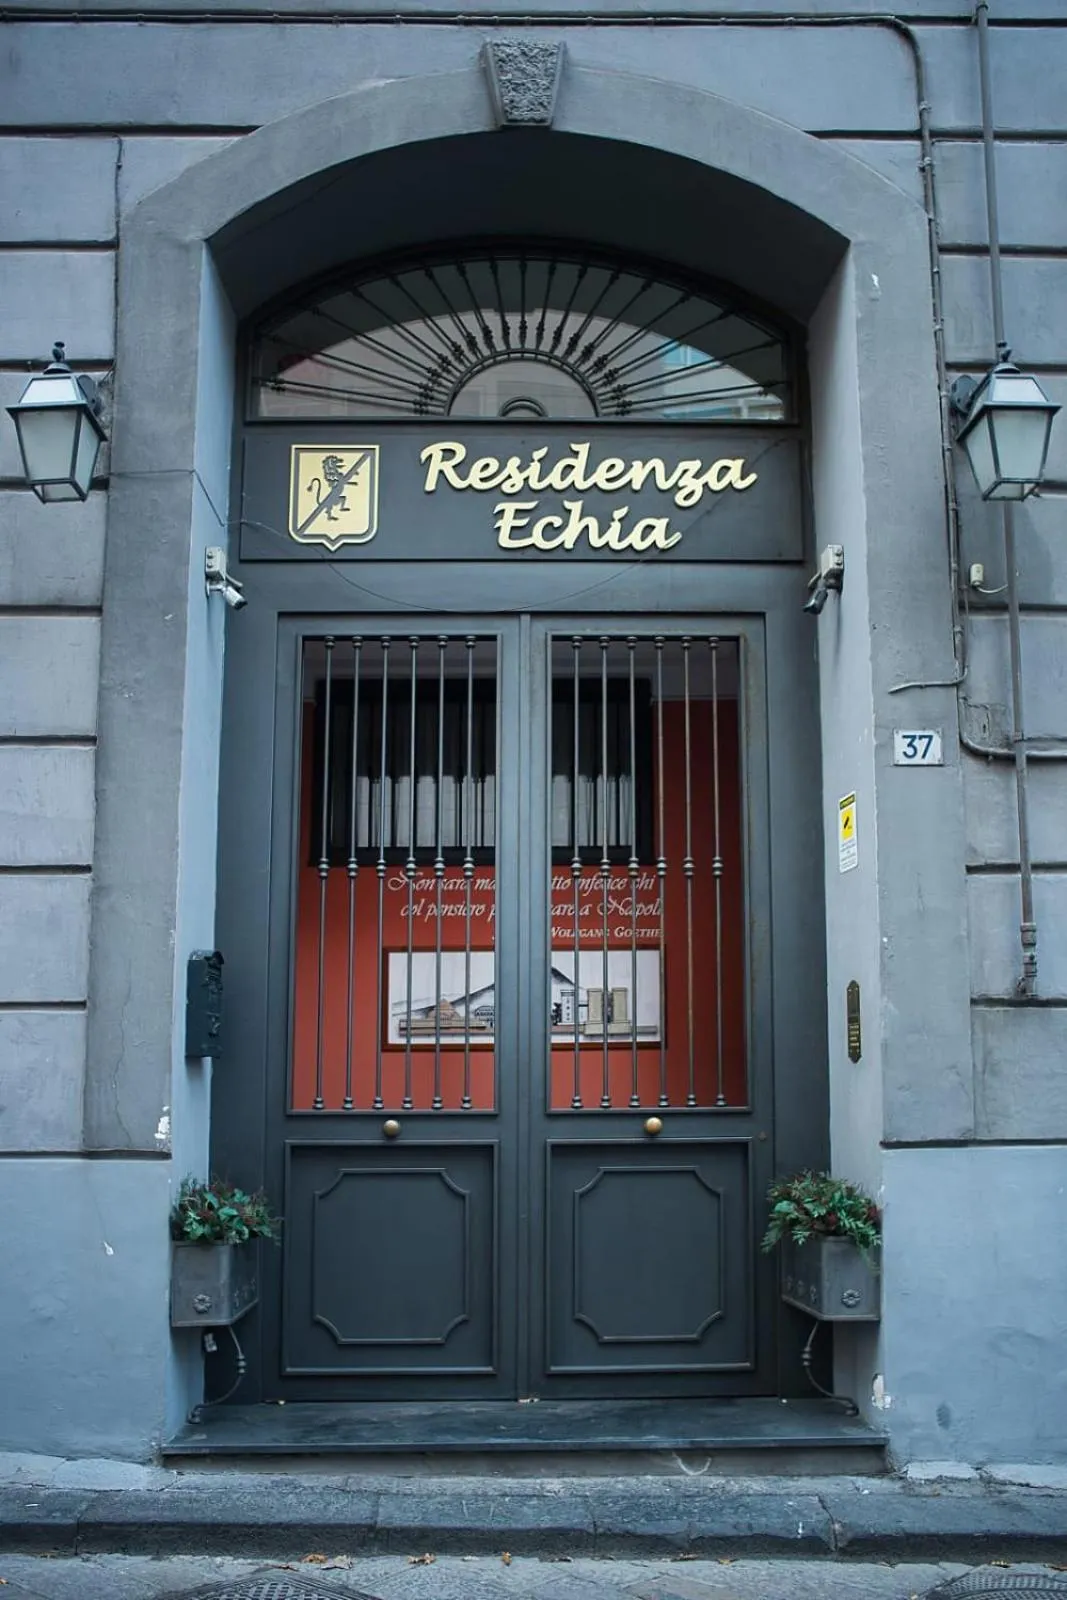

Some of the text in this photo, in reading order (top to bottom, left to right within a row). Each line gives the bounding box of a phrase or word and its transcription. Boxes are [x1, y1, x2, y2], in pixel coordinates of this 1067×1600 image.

[420, 442, 758, 508] Residenza
[494, 500, 682, 552] Echia
[902, 735, 934, 759] 37
[597, 896, 661, 918] Napol
